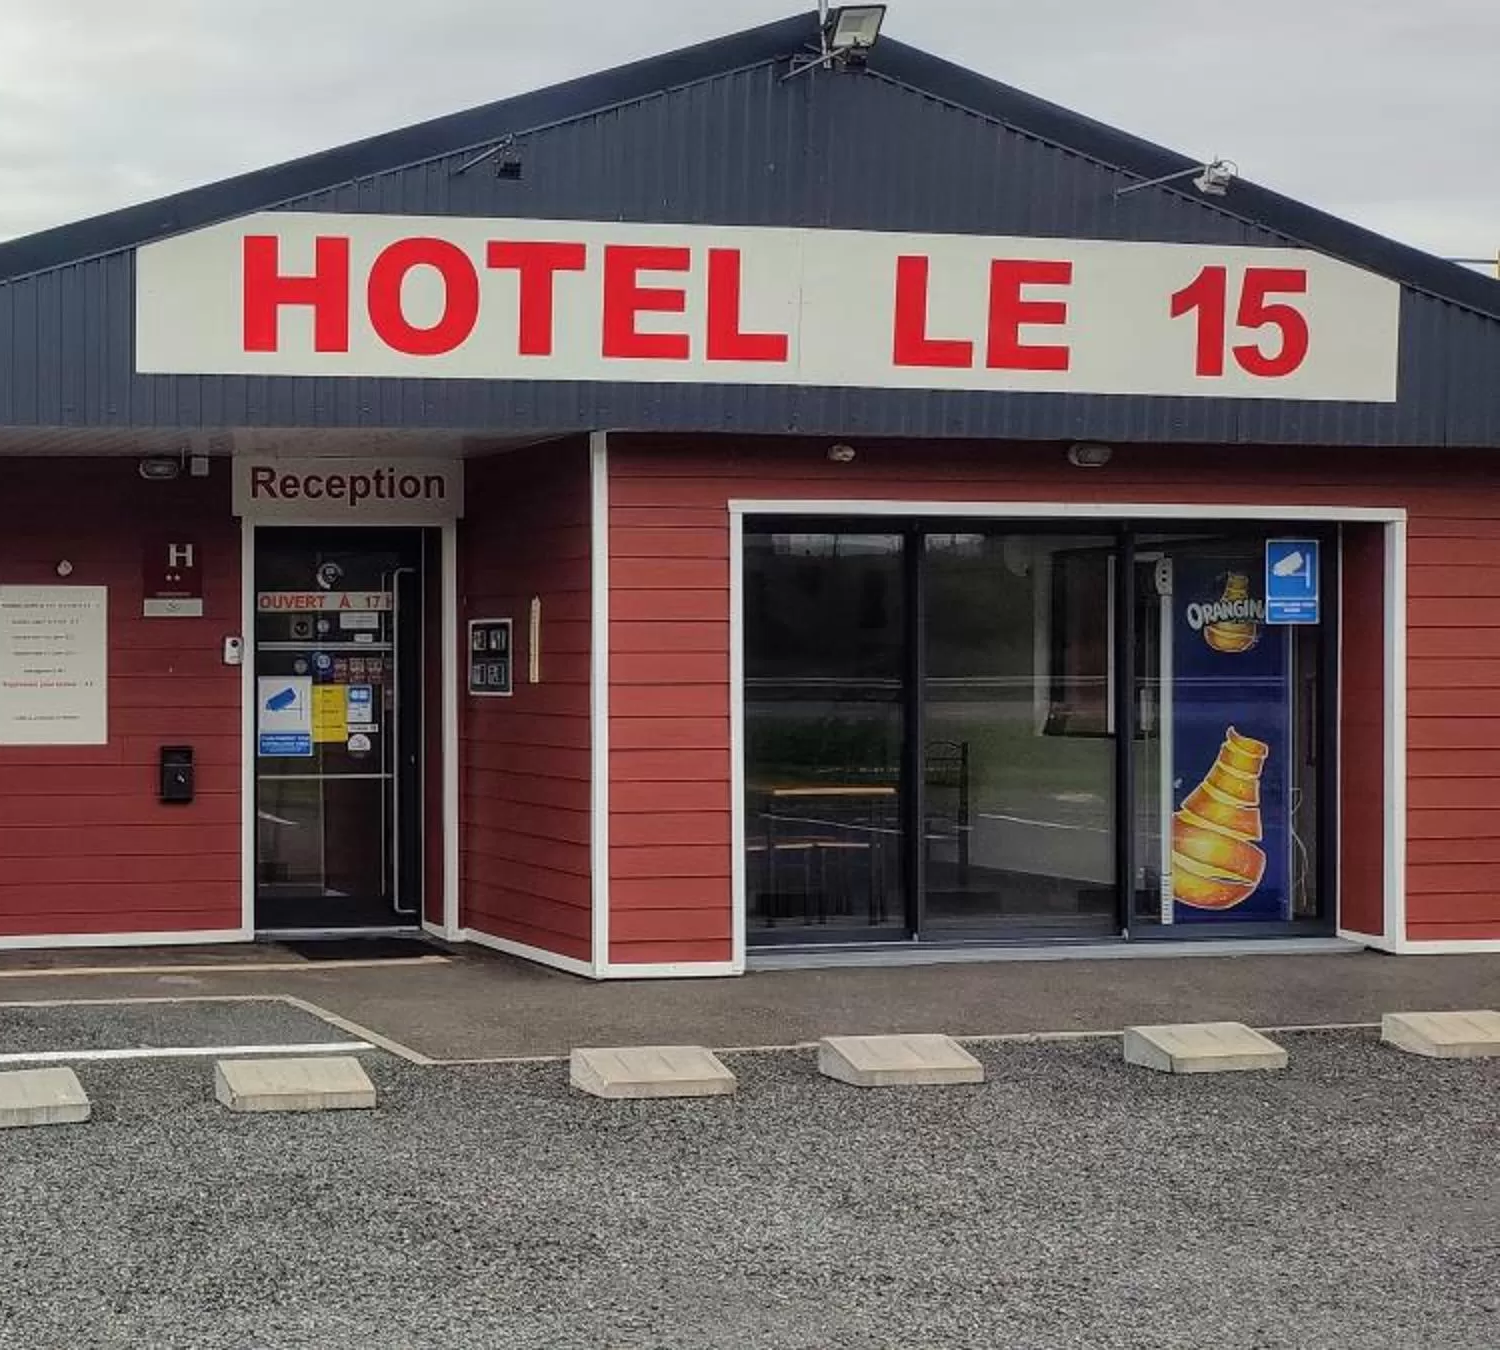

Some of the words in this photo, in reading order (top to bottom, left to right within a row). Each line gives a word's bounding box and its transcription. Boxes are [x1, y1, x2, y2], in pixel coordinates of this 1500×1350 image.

[242, 235, 788, 361] HOTEL
[892, 255, 1072, 371] LE
[1169, 266, 1308, 377] 15
[251, 466, 445, 506] Reception
[169, 543, 193, 567] H
[260, 595, 324, 609] OUVERT
[1187, 599, 1266, 630] ORANGIN
